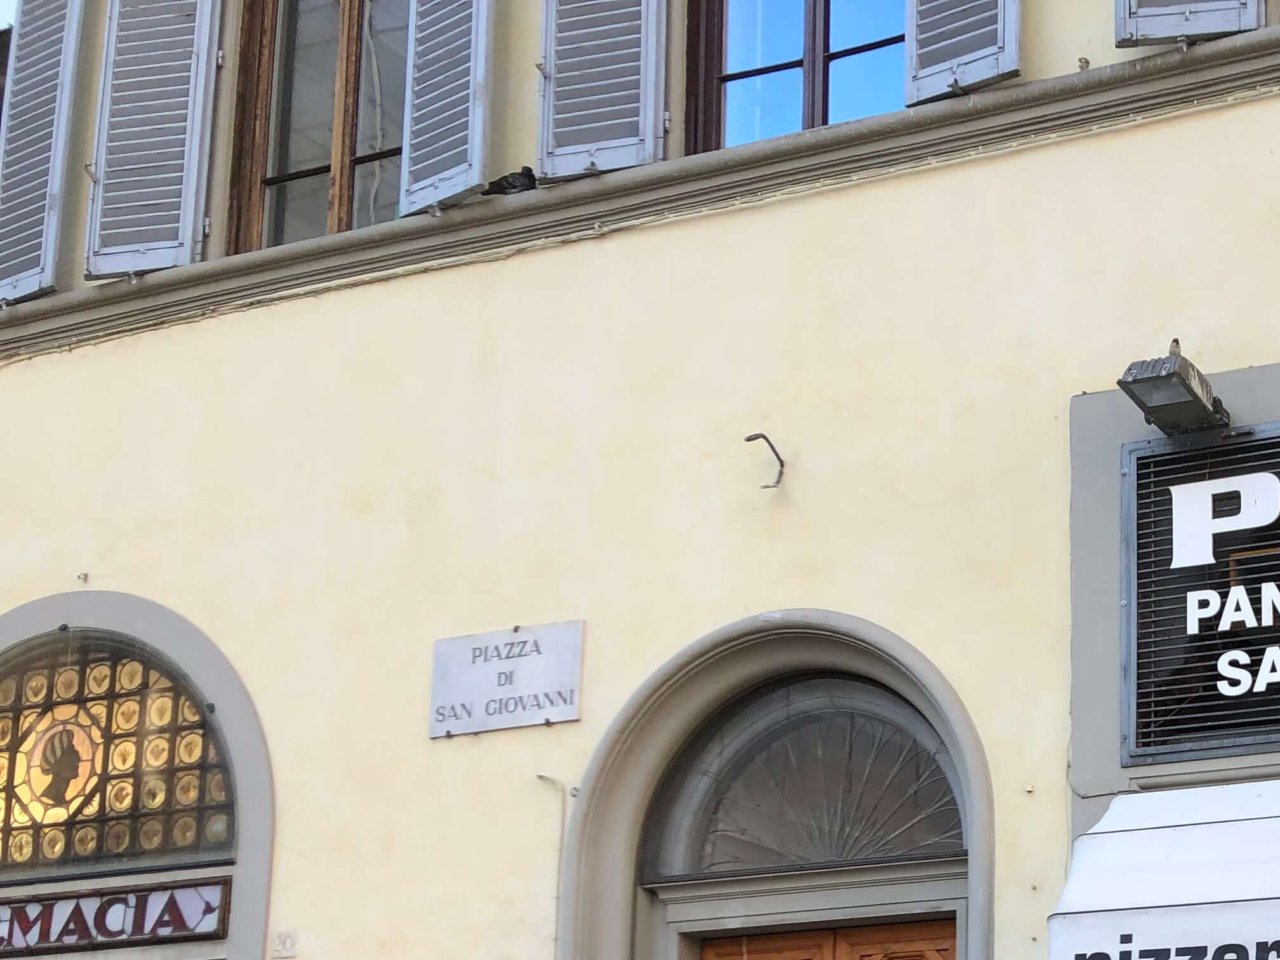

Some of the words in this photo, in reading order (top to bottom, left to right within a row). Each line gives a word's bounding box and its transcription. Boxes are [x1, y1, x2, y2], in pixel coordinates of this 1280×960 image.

[471, 639, 542, 664] PIAZZA
[497, 671, 514, 687] DI
[435, 702, 473, 723] SAN
[484, 689, 575, 716] GIOVANNI
[0, 889, 192, 948] MACIA
